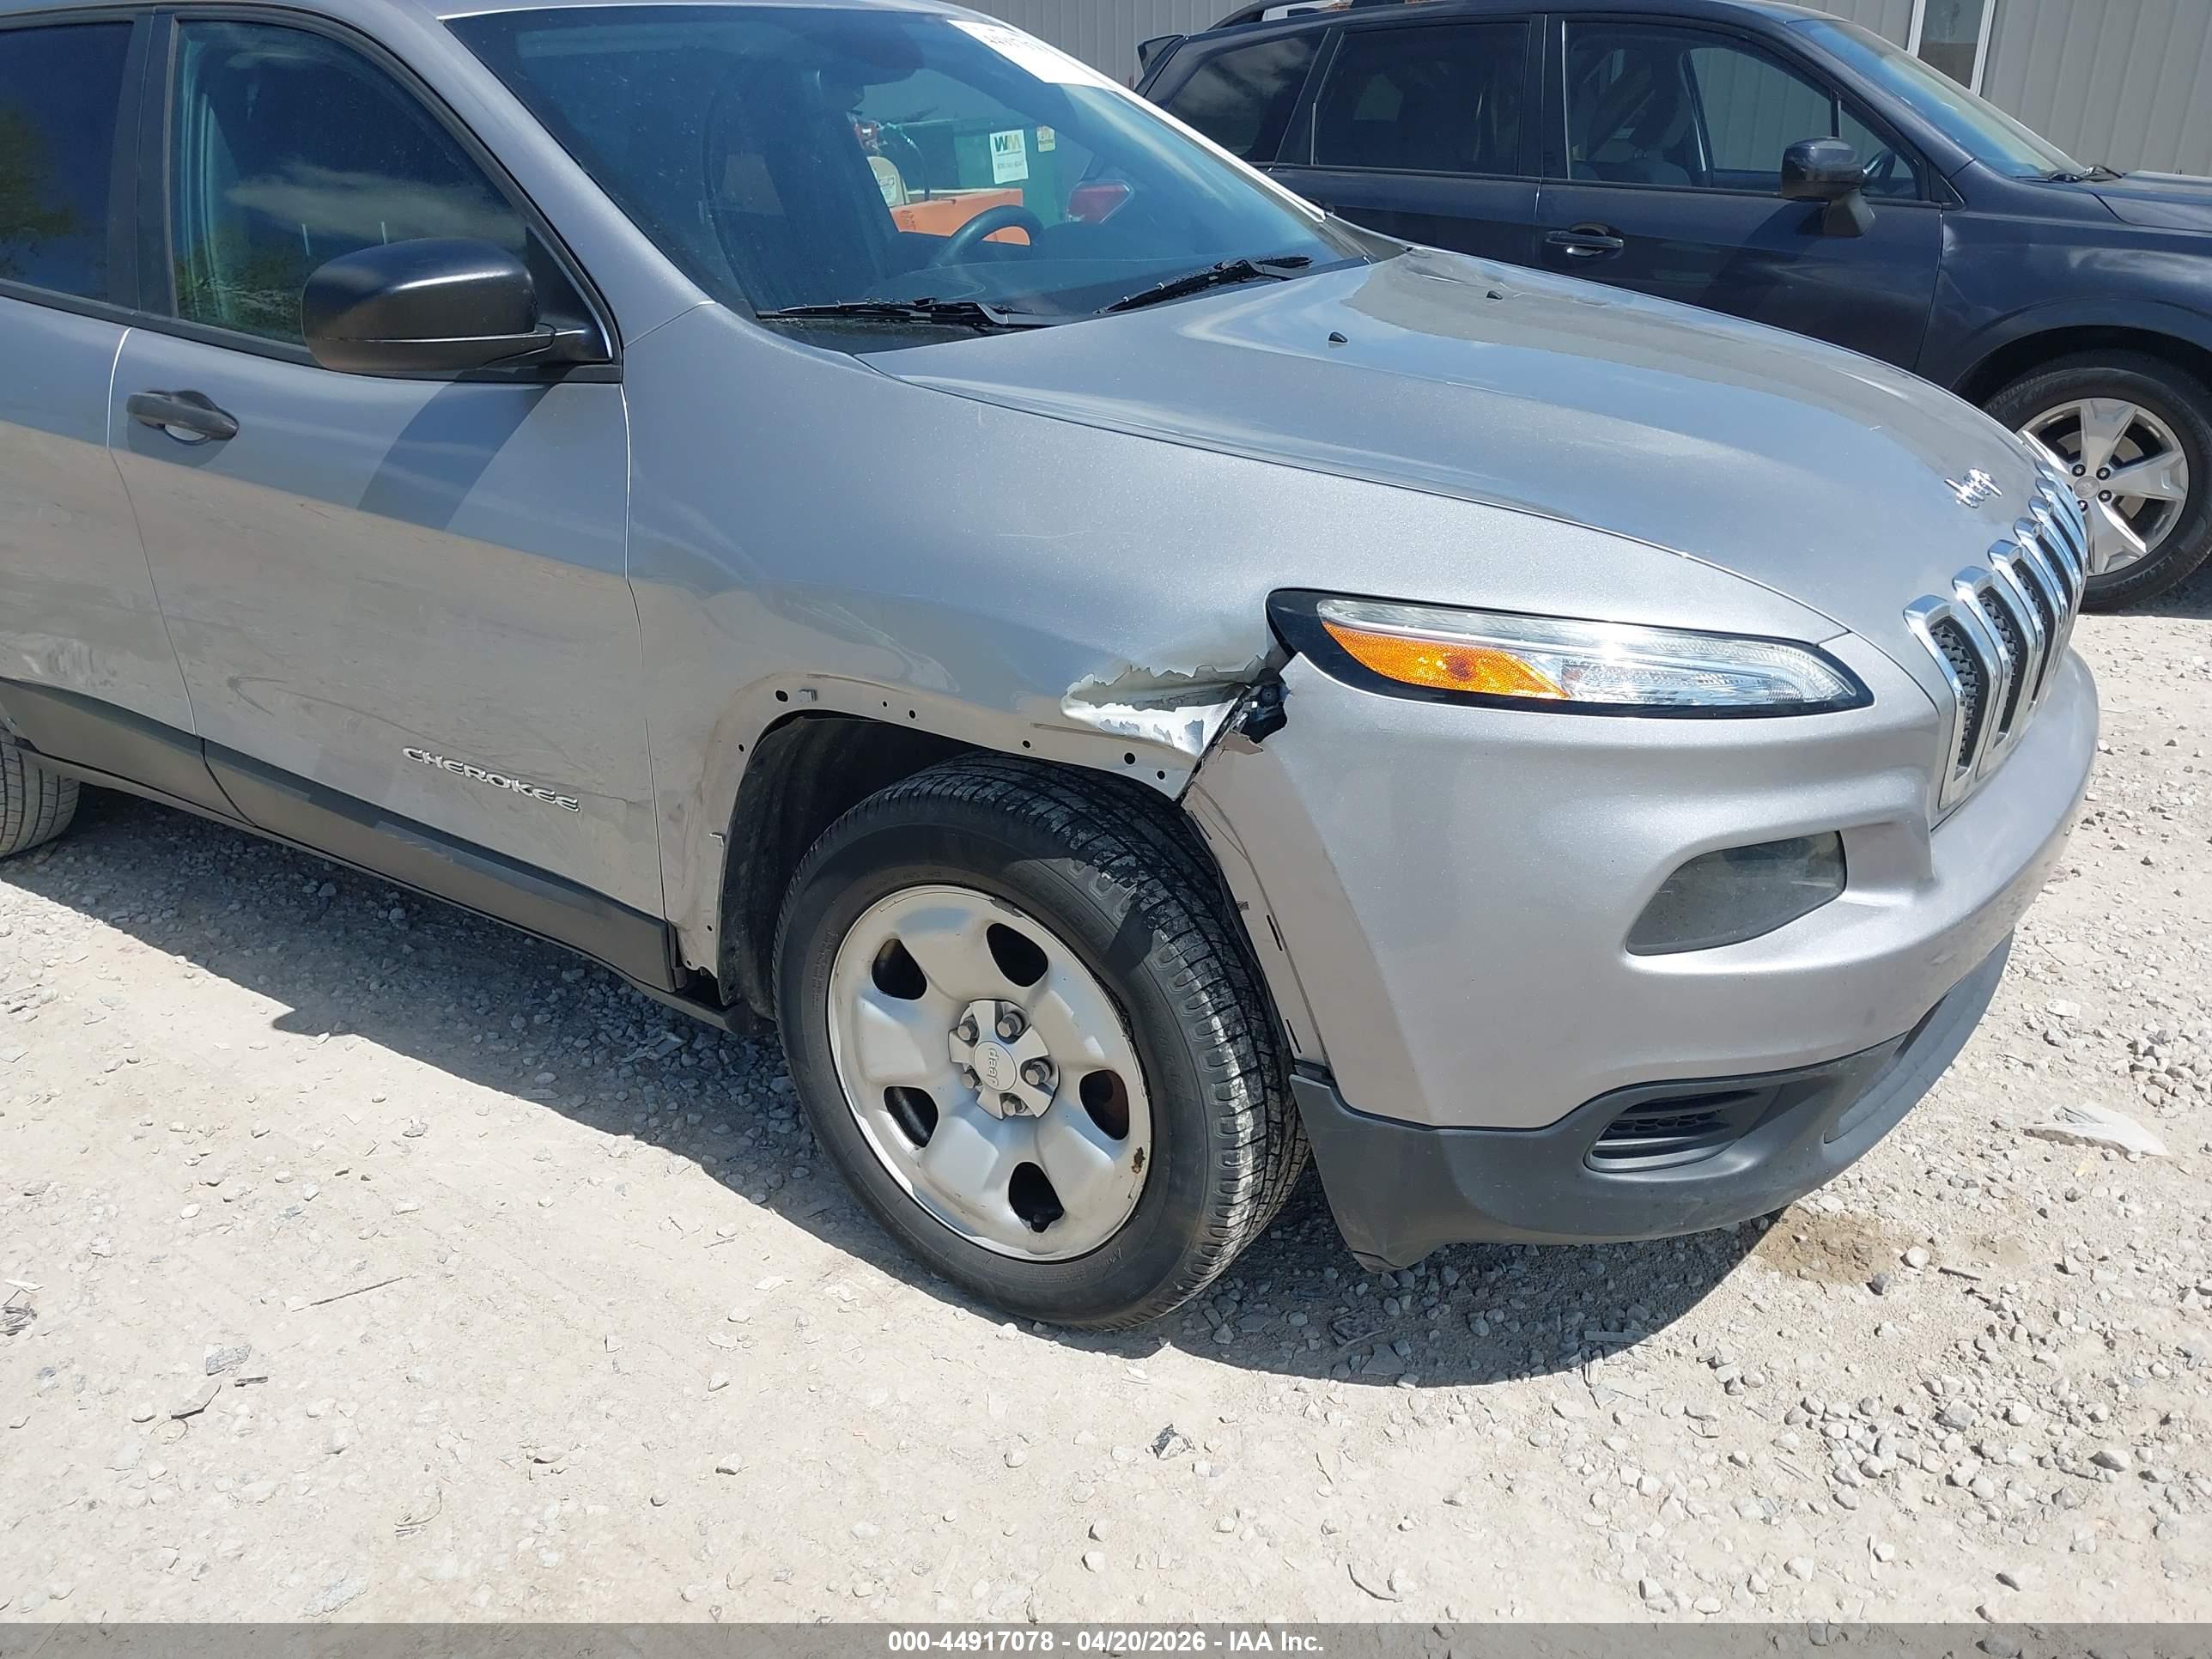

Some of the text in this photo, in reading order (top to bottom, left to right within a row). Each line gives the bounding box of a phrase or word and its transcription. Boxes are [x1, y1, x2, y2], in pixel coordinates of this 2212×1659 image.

[994, 134, 1022, 152] WM
[402, 746, 580, 812] CHEROKEE
[988, 1047, 1000, 1086] Jeep
